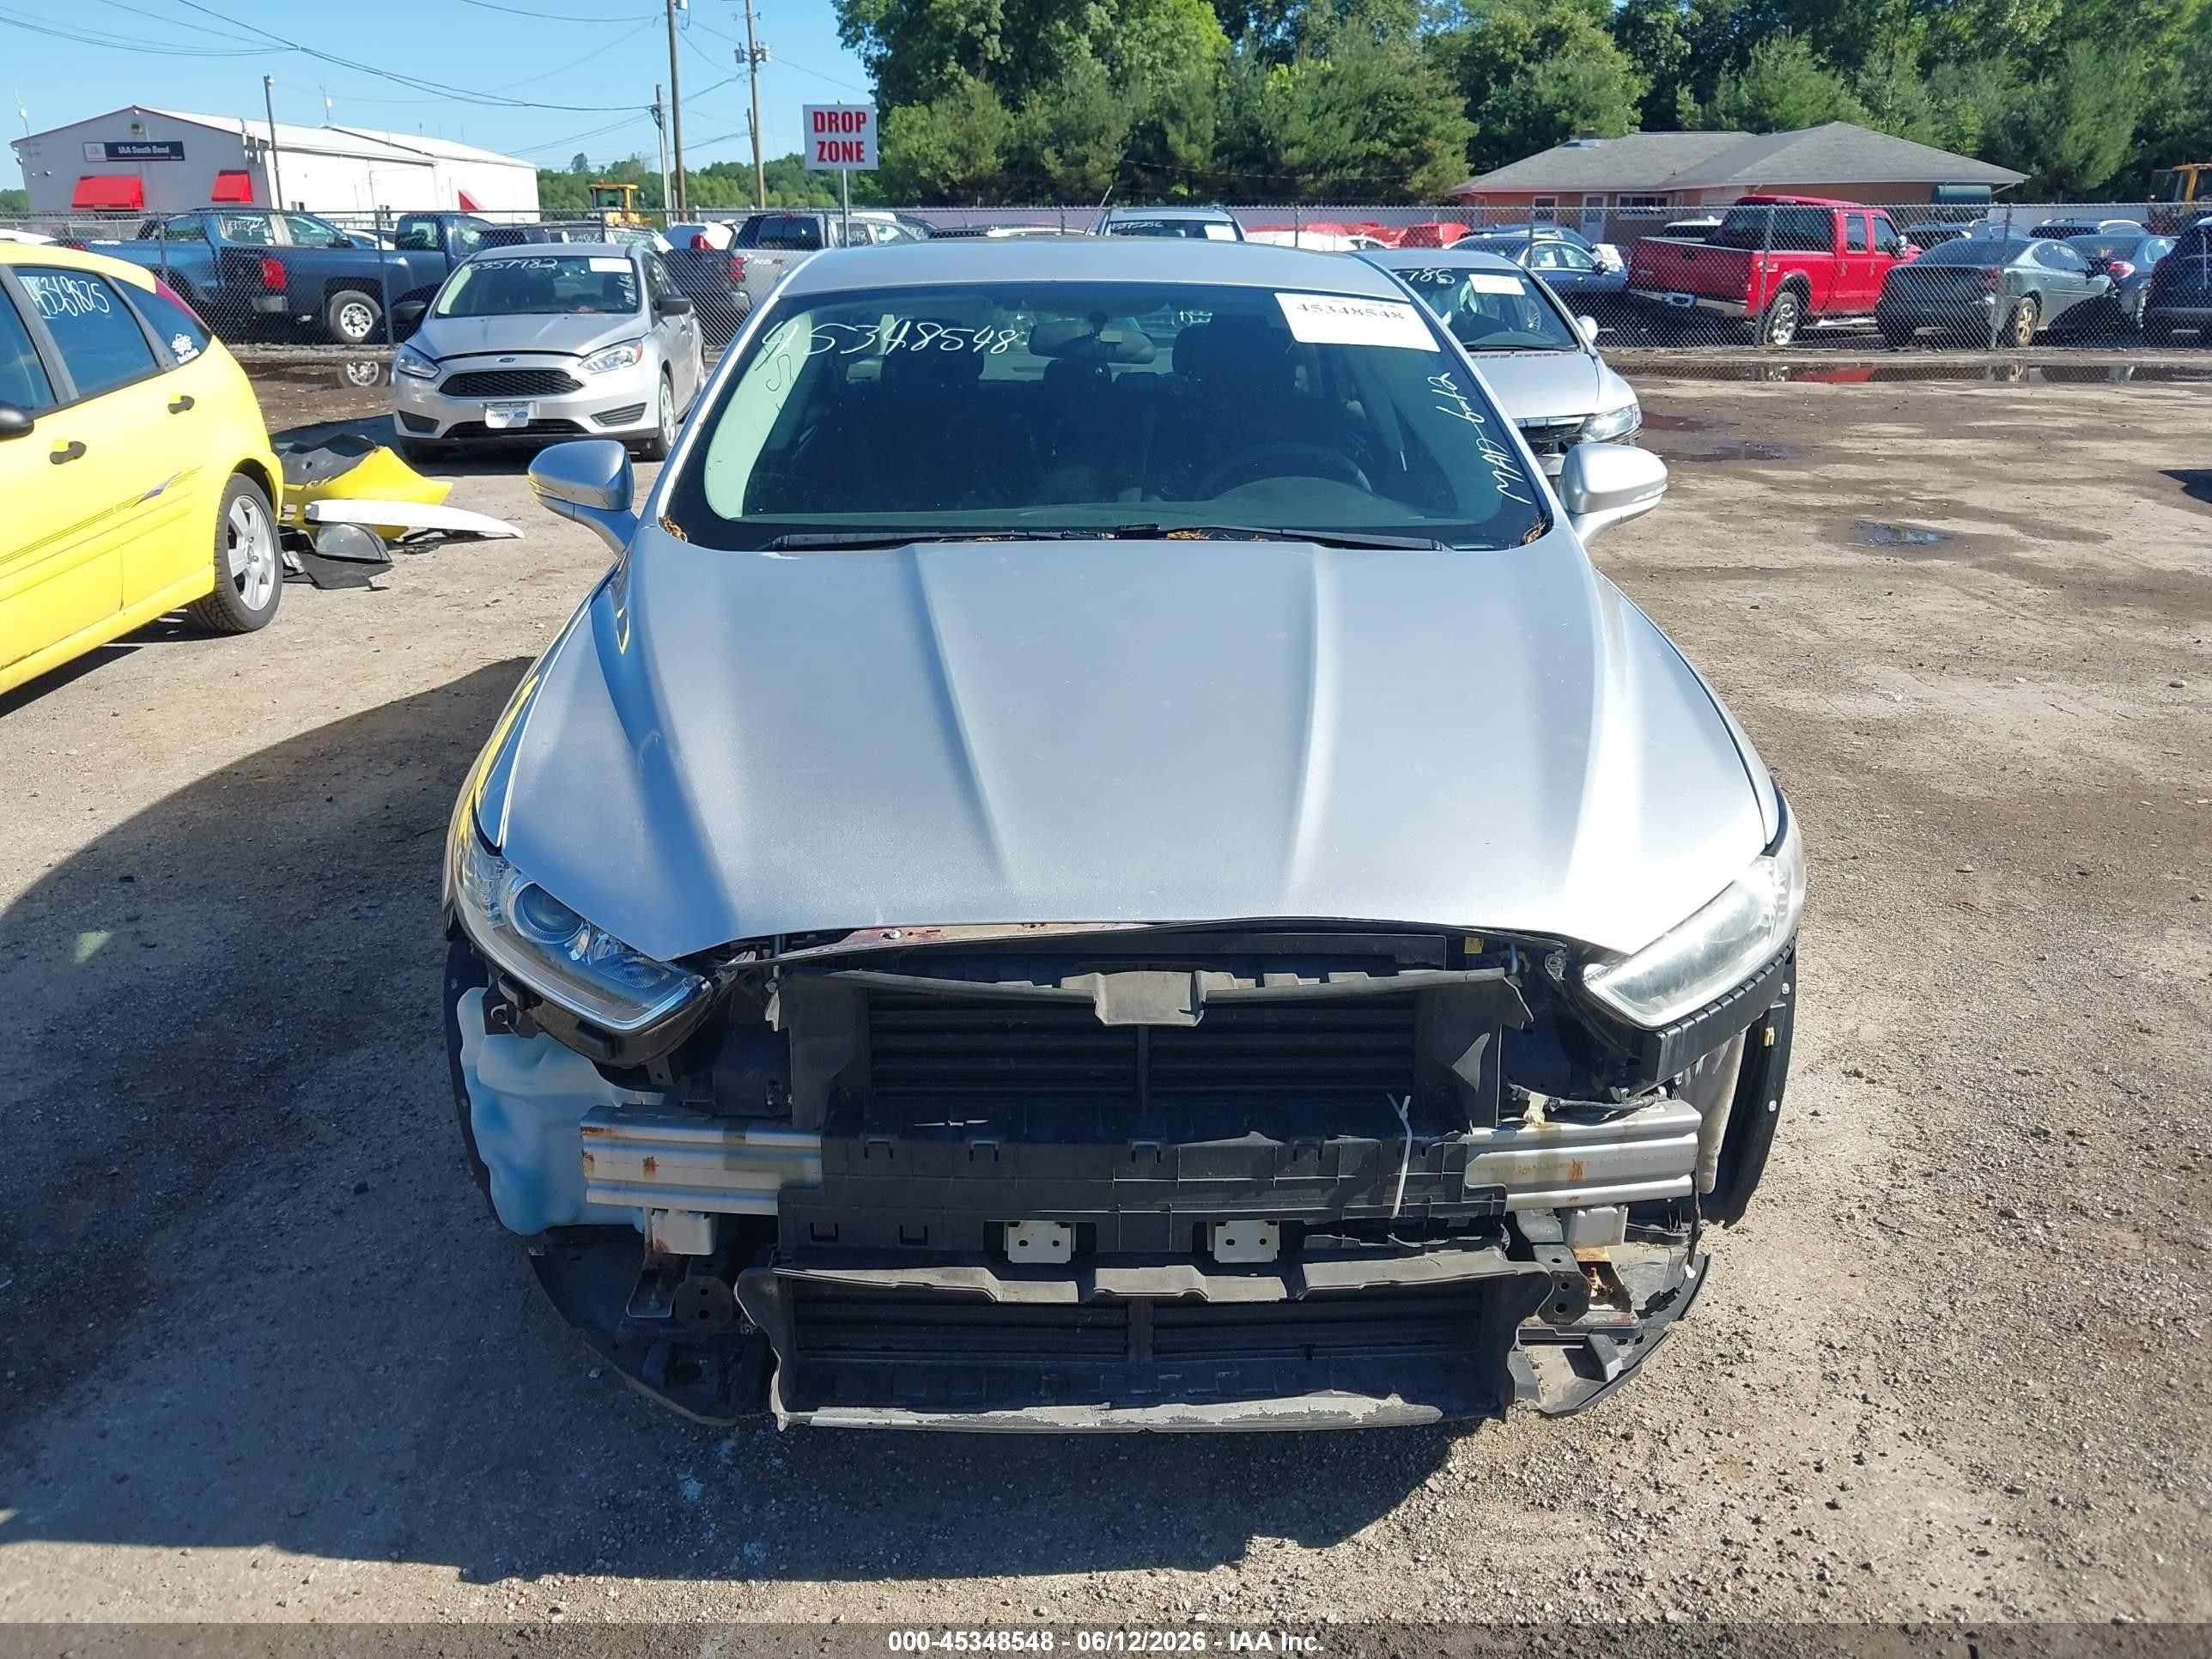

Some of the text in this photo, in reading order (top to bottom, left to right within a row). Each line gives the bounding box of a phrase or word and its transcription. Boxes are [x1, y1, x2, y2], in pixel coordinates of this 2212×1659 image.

[813, 111, 866, 133] DROP
[817, 140, 865, 163] ZONE
[1297, 303, 1405, 320] 45348548
[762, 318, 1019, 356] 45348548
